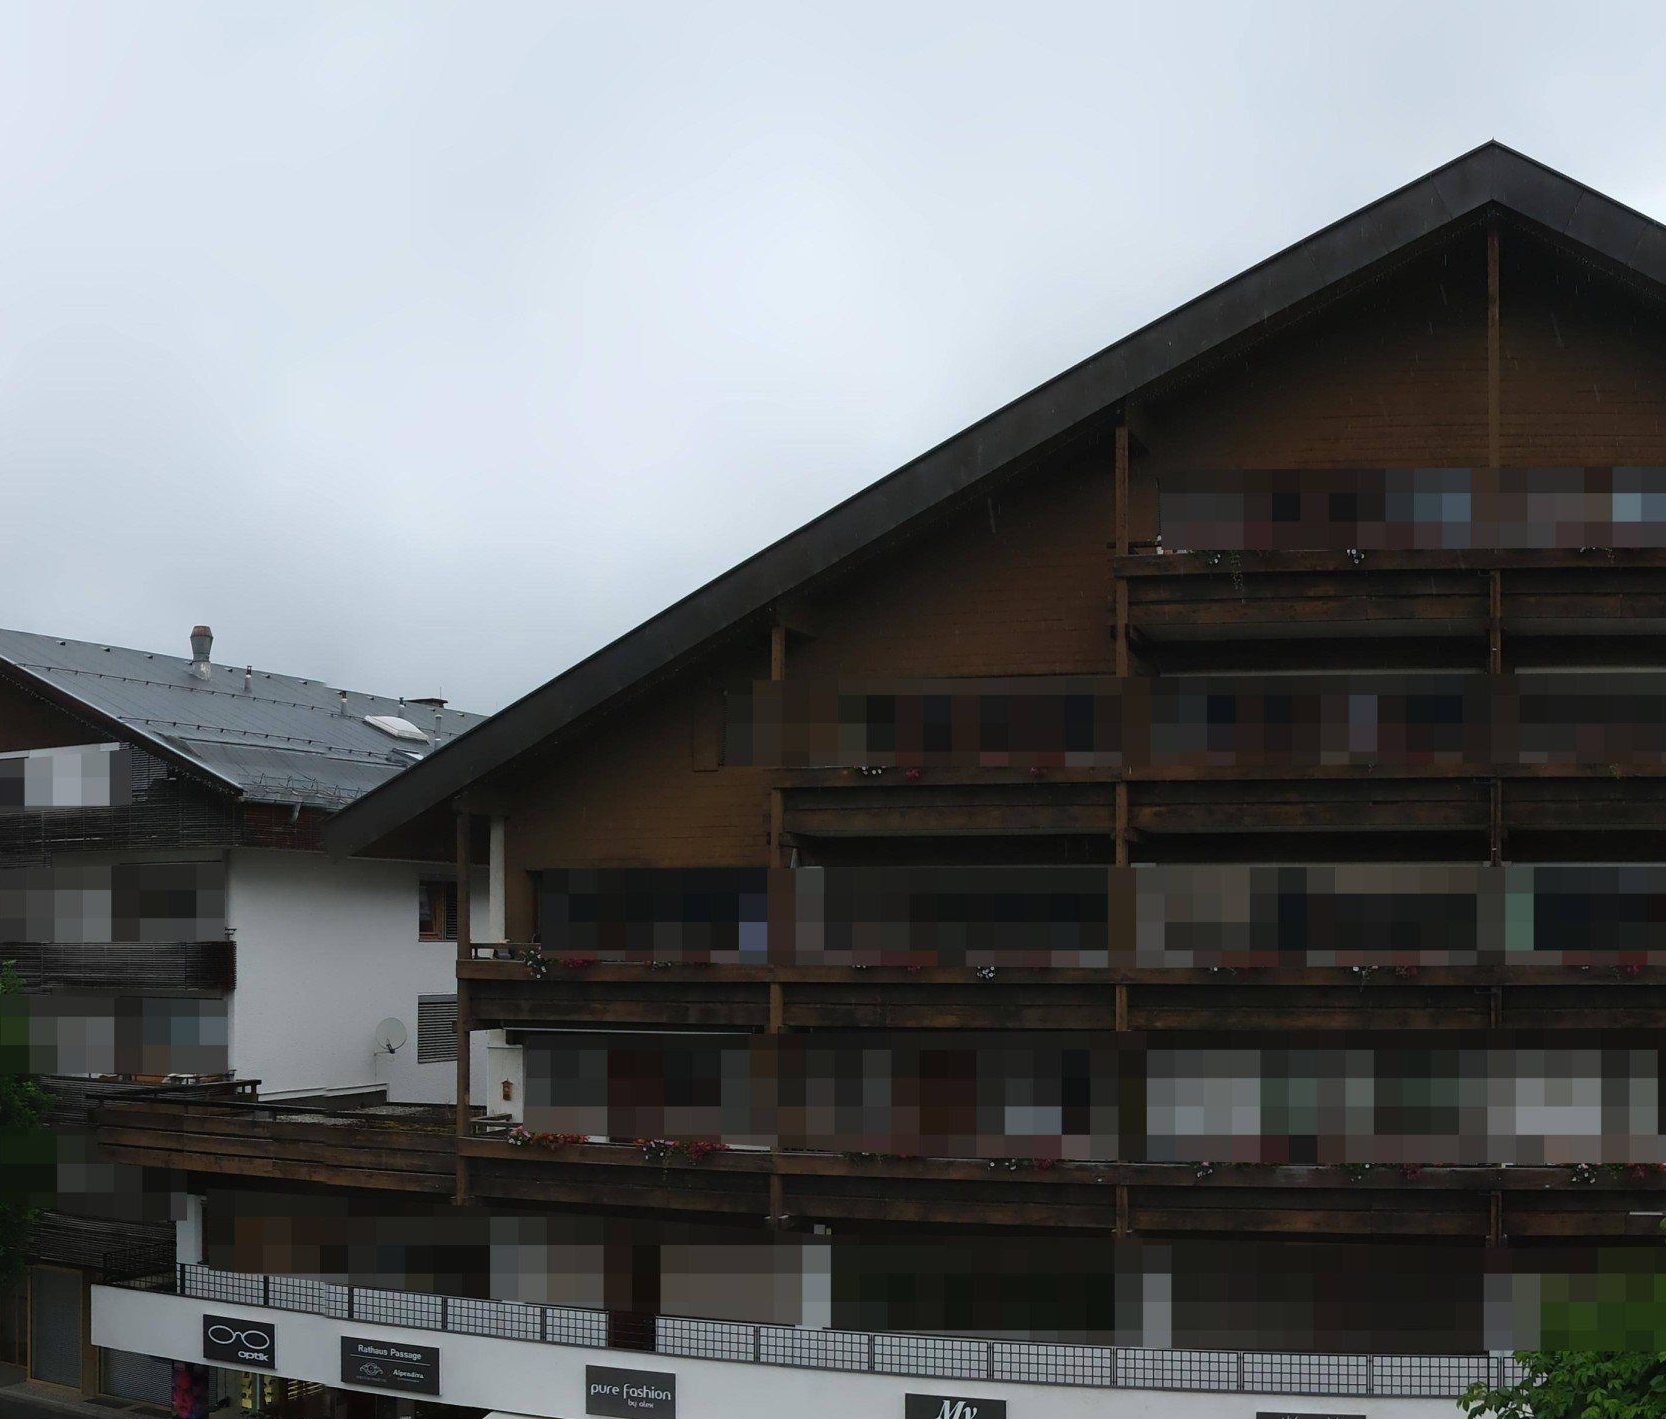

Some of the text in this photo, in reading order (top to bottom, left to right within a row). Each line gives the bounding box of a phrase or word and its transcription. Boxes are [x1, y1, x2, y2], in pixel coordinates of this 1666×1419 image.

[238, 1350, 269, 1362] optik
[358, 1344, 422, 1360] Rathaus Passage
[590, 1383, 671, 1400] pure fashion
[627, 1399, 637, 1408] by
